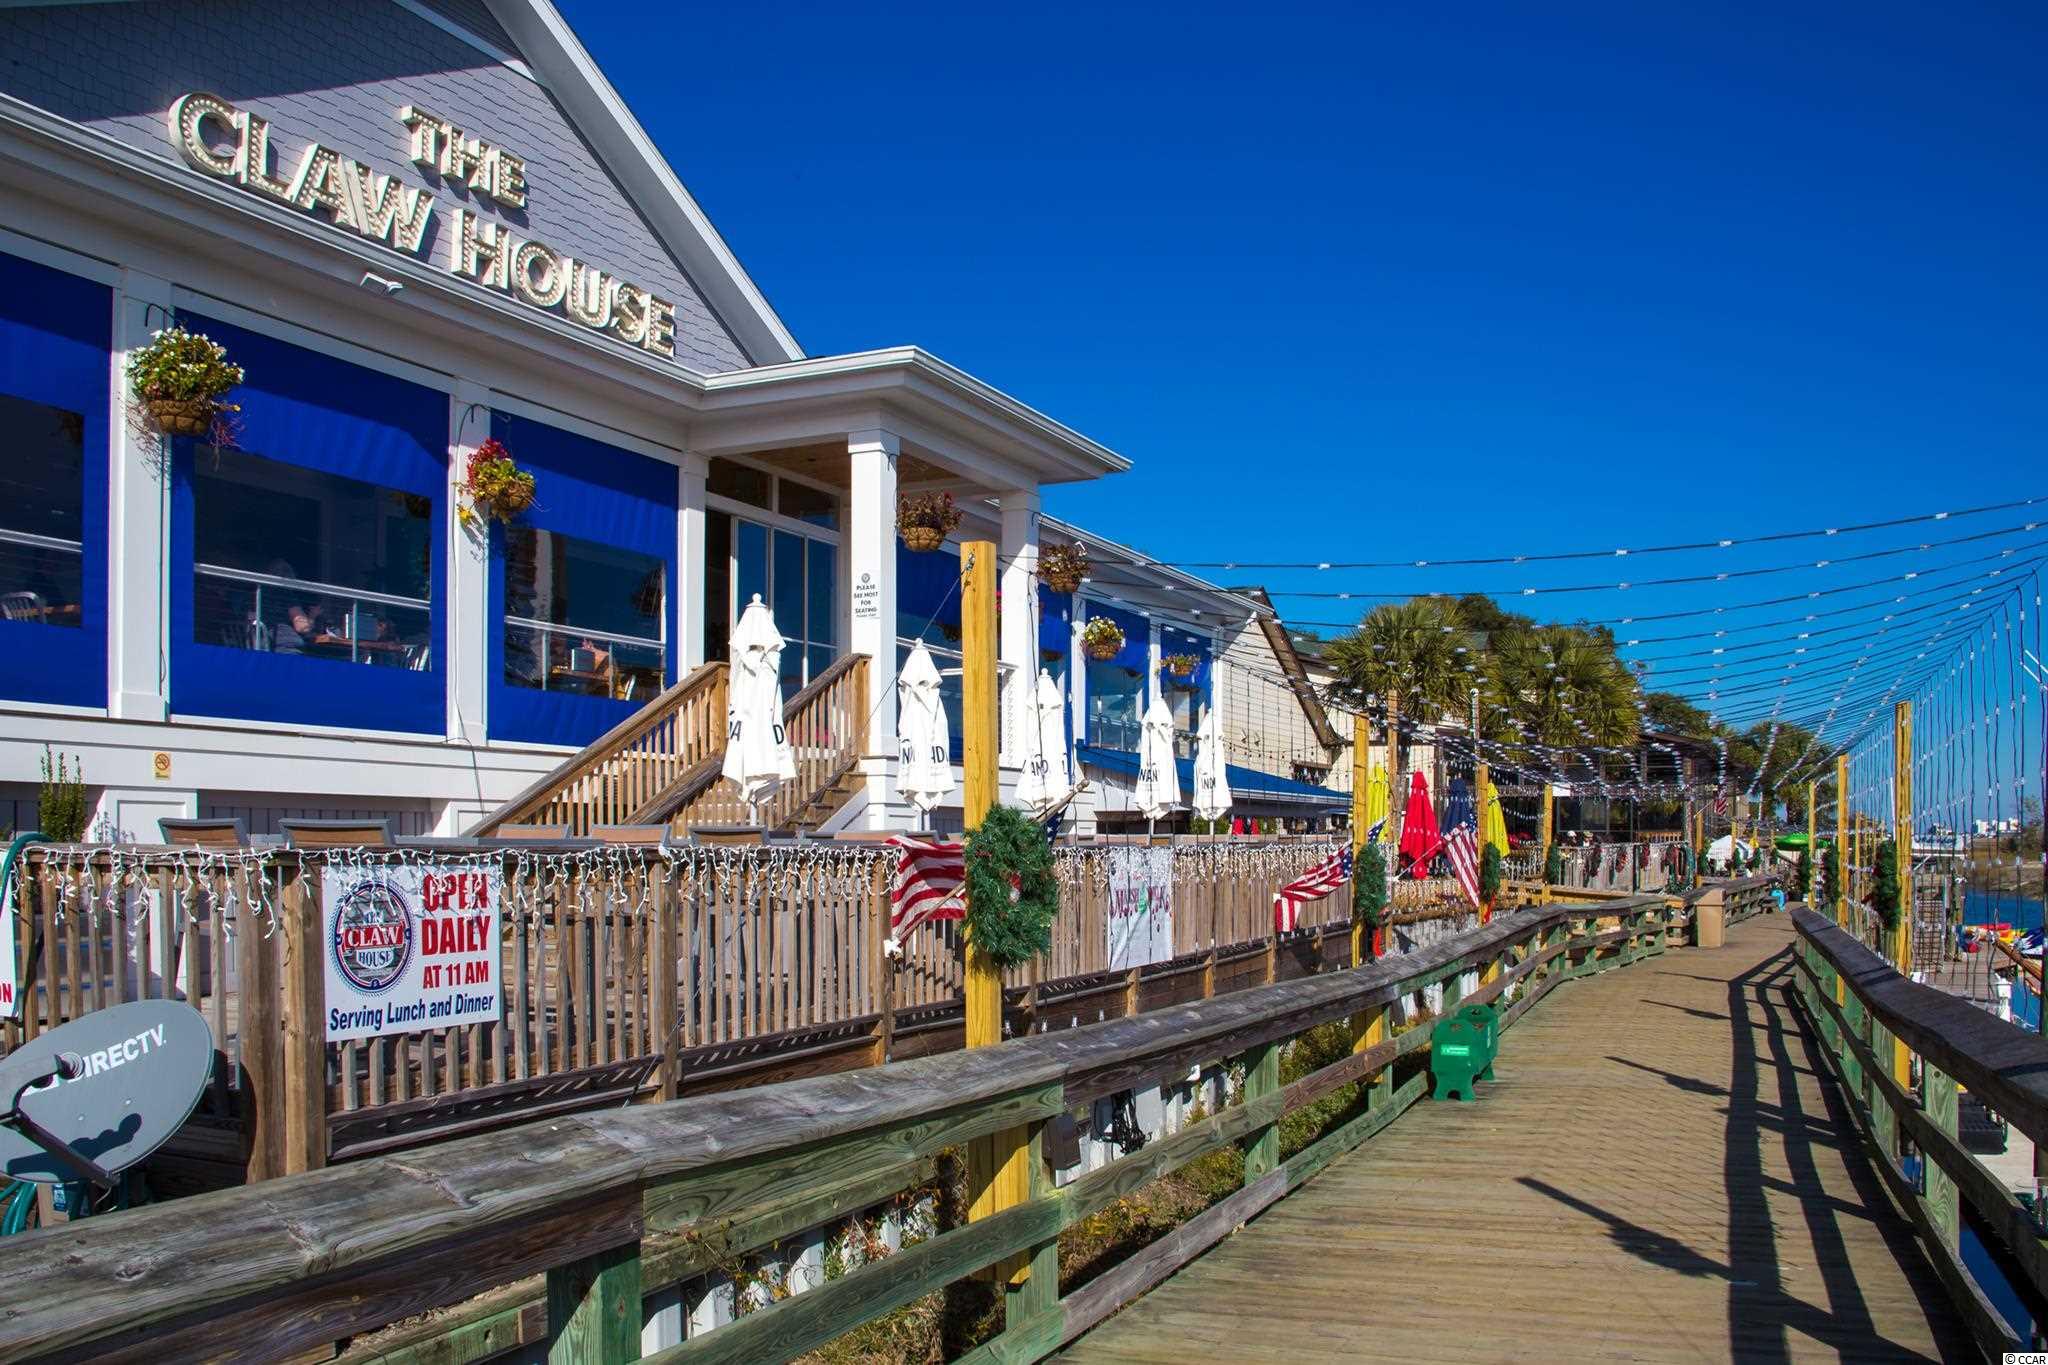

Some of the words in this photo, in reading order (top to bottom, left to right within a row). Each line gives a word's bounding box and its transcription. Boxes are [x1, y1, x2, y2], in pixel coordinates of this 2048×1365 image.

[400, 104, 526, 208] THE
[167, 91, 434, 253] CLAW
[451, 208, 677, 360] HOUSE
[856, 583, 875, 591] PLEASE
[422, 873, 490, 912] OPEN
[347, 925, 400, 947] CLAW
[421, 915, 491, 956] DAILY
[358, 949, 392, 968] HOUSE
[423, 964, 442, 989] AT
[445, 962, 460, 986] 11
[465, 960, 489, 985] AM
[0, 983, 12, 1003] N
[330, 1005, 383, 1031] Serving
[387, 998, 425, 1024] Lunch
[430, 995, 451, 1017] and
[455, 993, 494, 1014] Dinner
